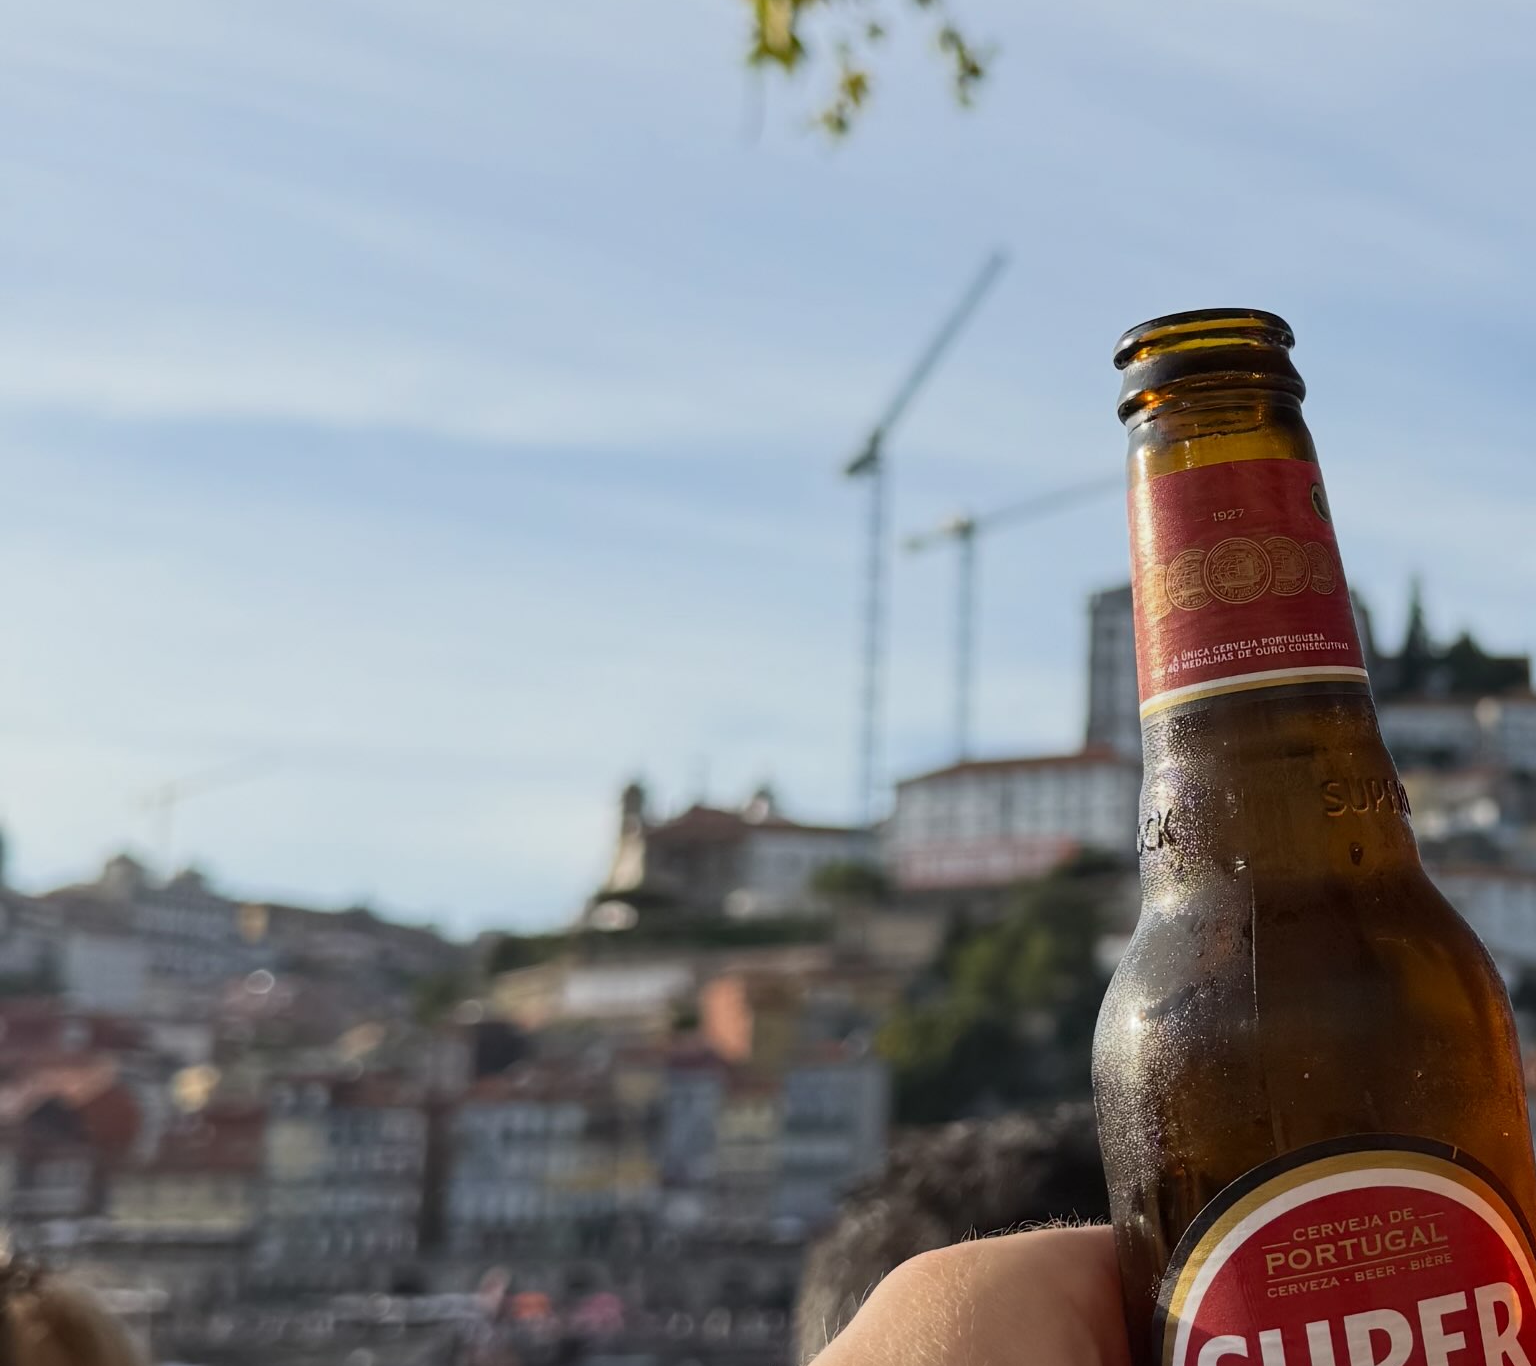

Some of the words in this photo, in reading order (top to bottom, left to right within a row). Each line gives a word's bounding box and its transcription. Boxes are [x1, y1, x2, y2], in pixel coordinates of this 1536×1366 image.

[1212, 508, 1245, 522] 1927
[1181, 652, 1234, 671] MEDALHAS
[1237, 648, 1252, 660] DE
[1255, 644, 1286, 656] OURO
[1212, 639, 1258, 654] CERVEJA
[1261, 632, 1326, 647] PORTUGUESA
[1292, 1213, 1384, 1243] CERVEJA
[1389, 1207, 1416, 1224] DE
[1265, 1221, 1449, 1276] PORTUGAL
[1266, 1276, 1340, 1299] CERVEZA
[1354, 1265, 1397, 1283] BEER
[1409, 1252, 1454, 1272] BIÈRE
